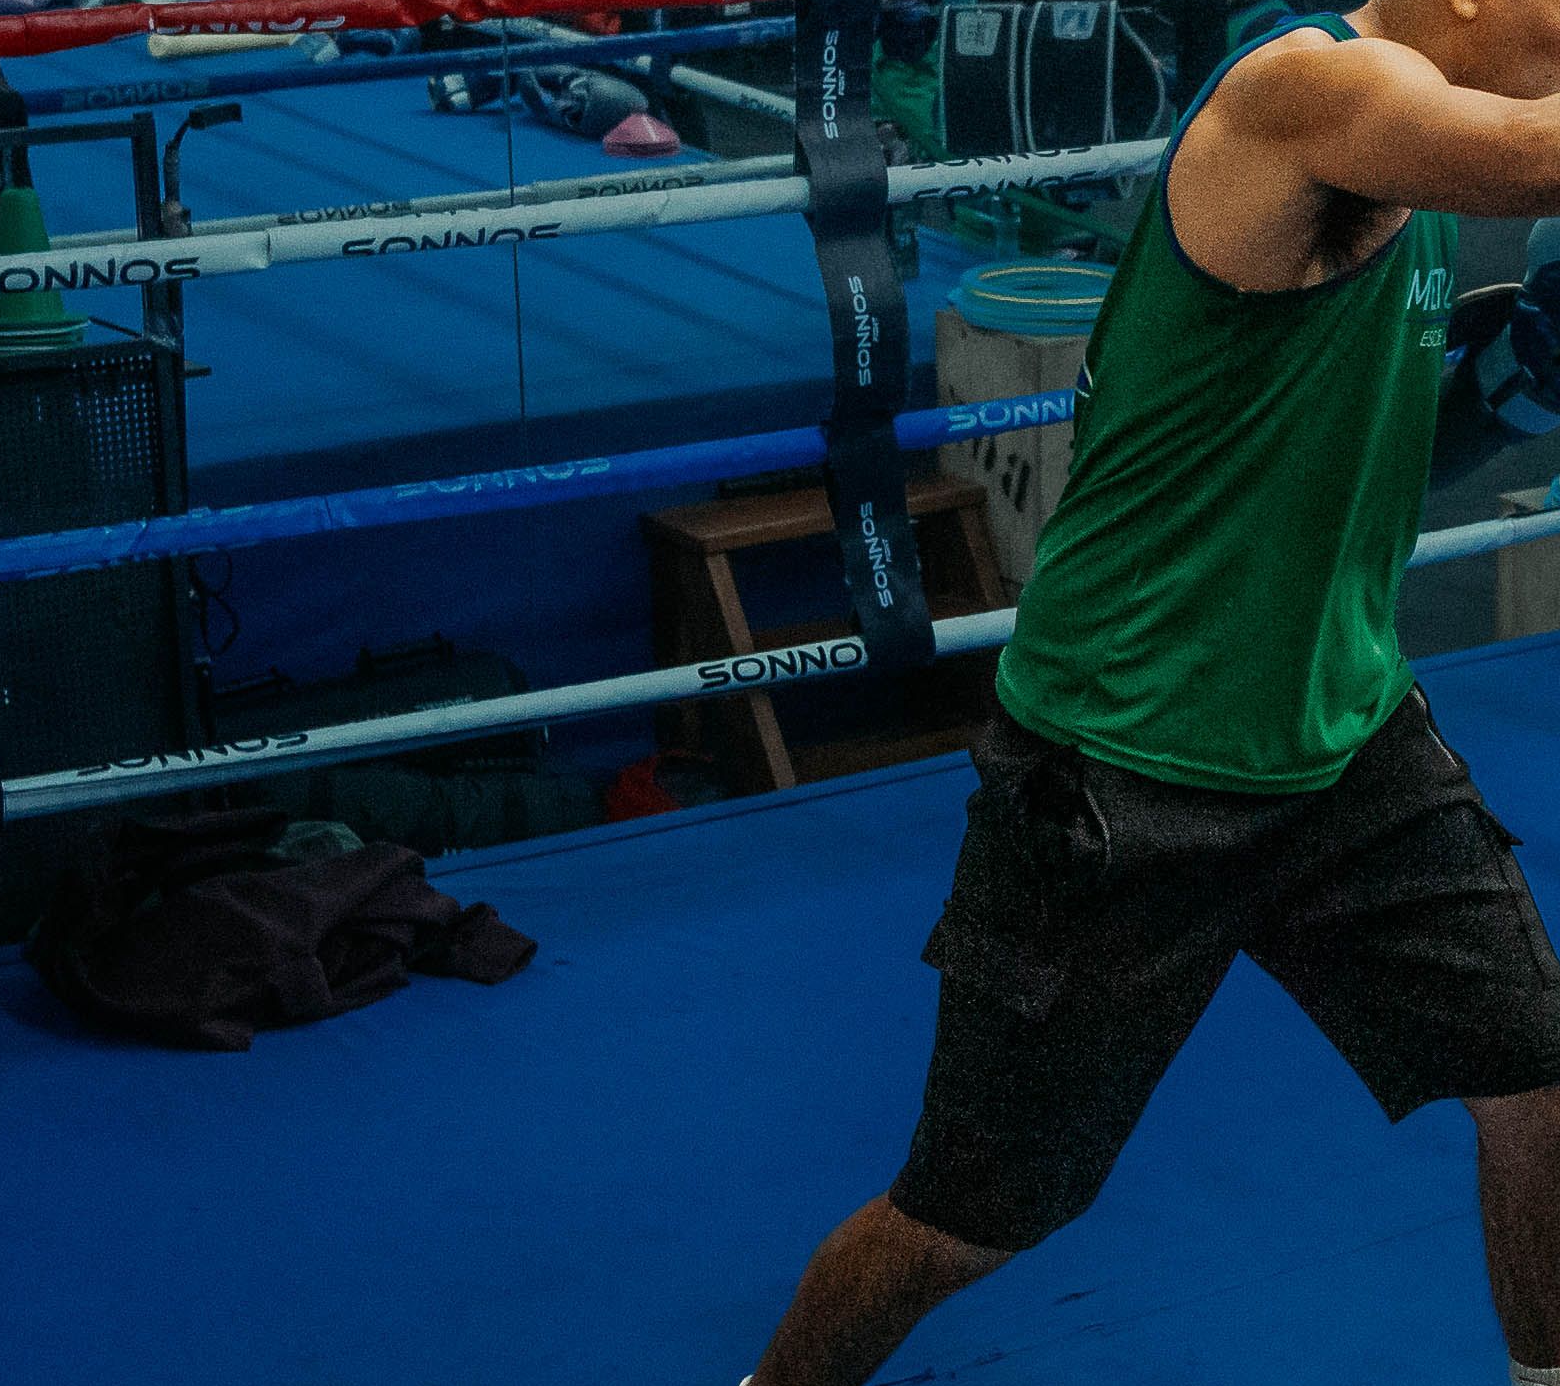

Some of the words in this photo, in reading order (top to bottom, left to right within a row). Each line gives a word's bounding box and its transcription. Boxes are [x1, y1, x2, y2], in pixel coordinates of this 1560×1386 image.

[822, 30, 840, 140] SONNOS
[342, 222, 563, 257] SONNOS
[848, 275, 872, 387] SONNOS
[948, 397, 1075, 432] SONN
[860, 501, 894, 609] SONNOS
[697, 641, 862, 690] SONNO
